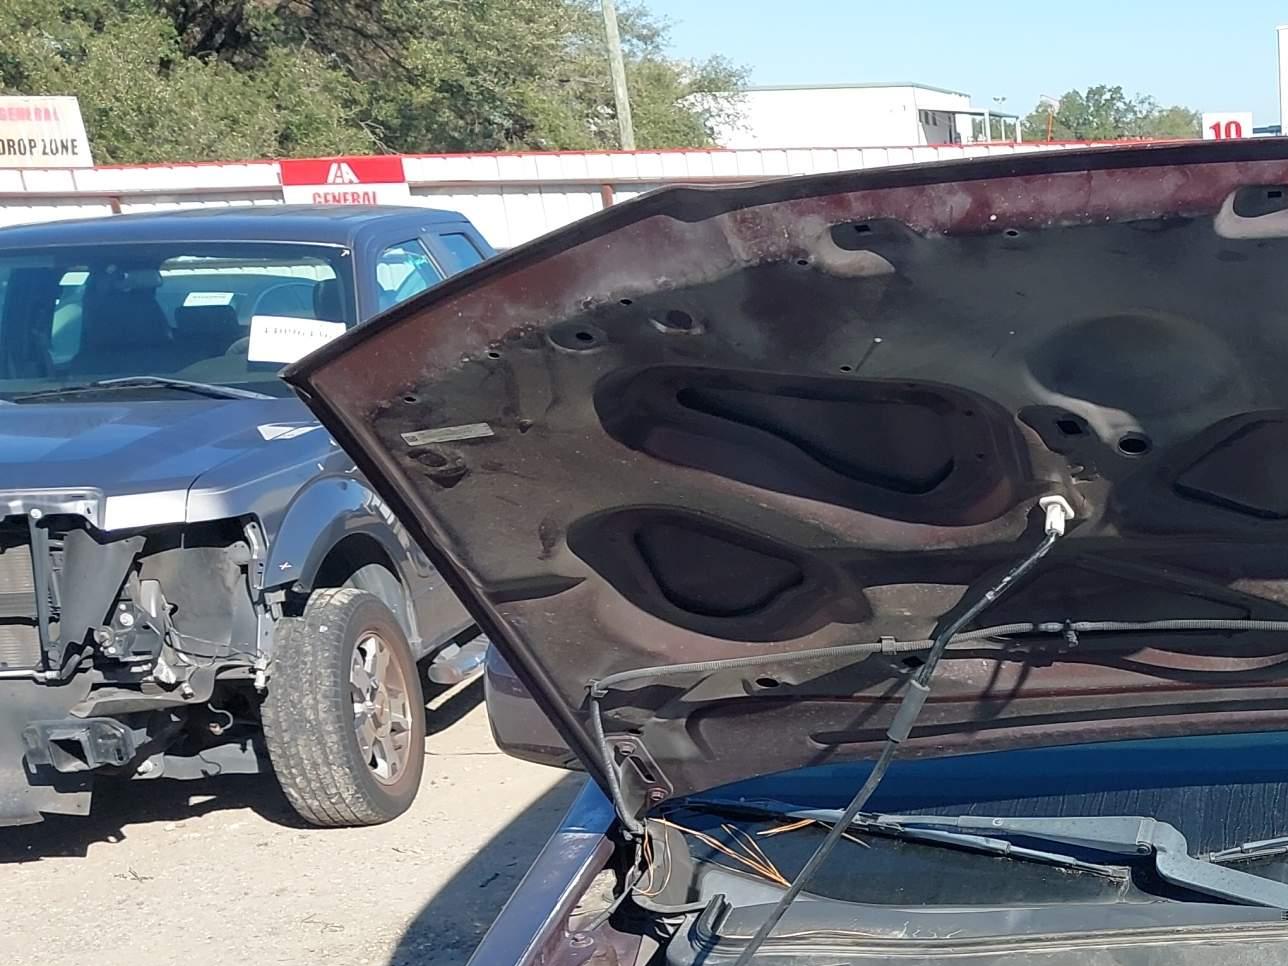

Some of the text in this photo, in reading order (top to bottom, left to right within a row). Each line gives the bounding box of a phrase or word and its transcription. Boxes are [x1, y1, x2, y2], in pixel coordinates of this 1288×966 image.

[1209, 120, 1242, 140] 10
[0, 138, 78, 156] DROP ZONE
